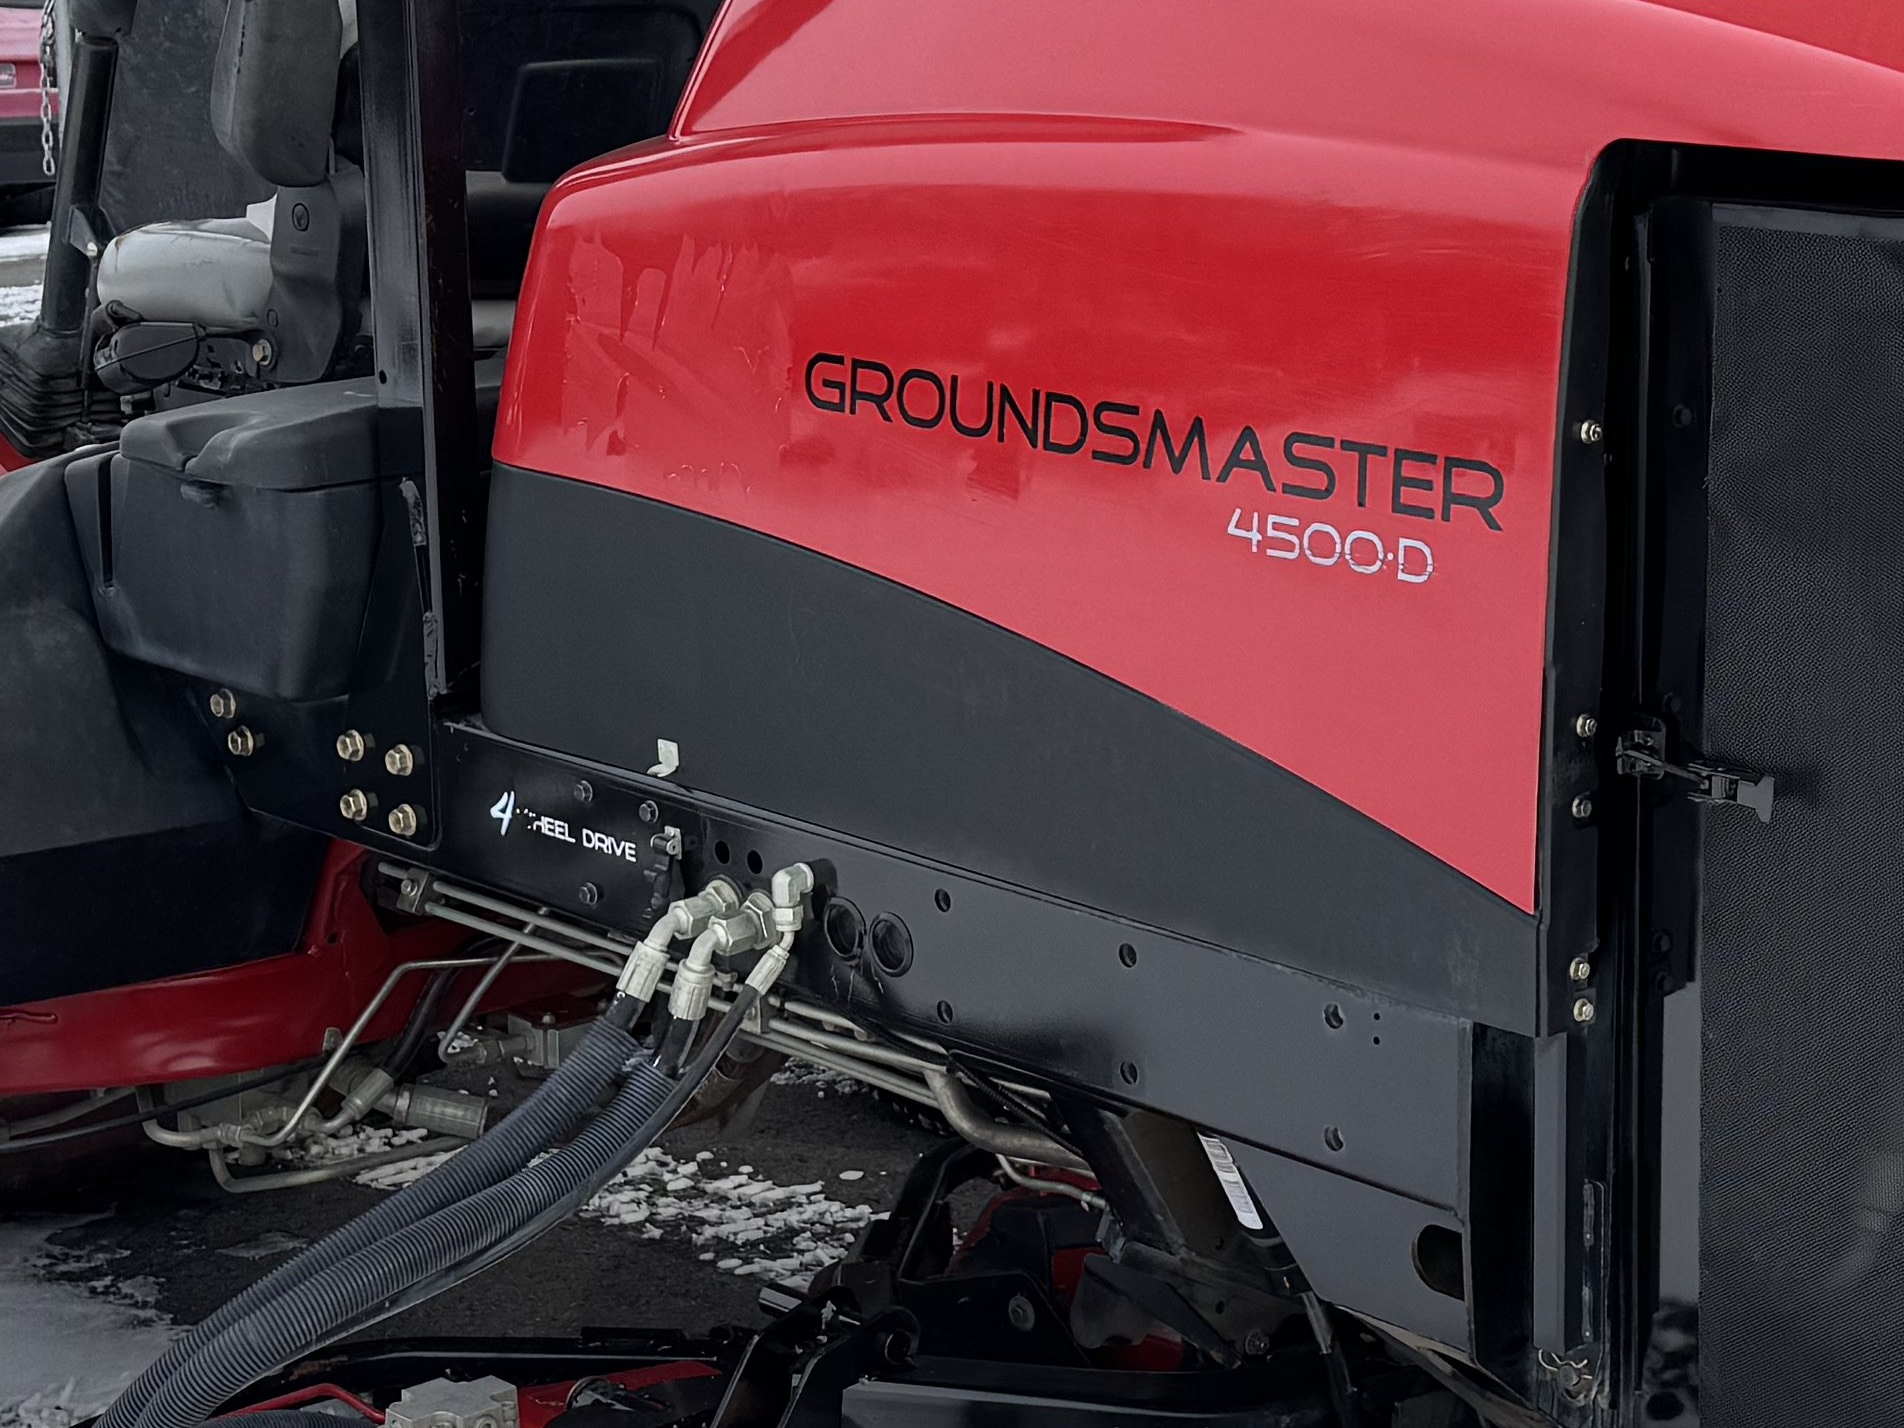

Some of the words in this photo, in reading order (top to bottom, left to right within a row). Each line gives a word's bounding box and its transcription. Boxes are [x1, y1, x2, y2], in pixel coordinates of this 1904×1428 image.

[804, 351, 1505, 531] GROUNDSMASTER
[490, 791, 515, 836] 4
[582, 828, 637, 862] DRIVE
